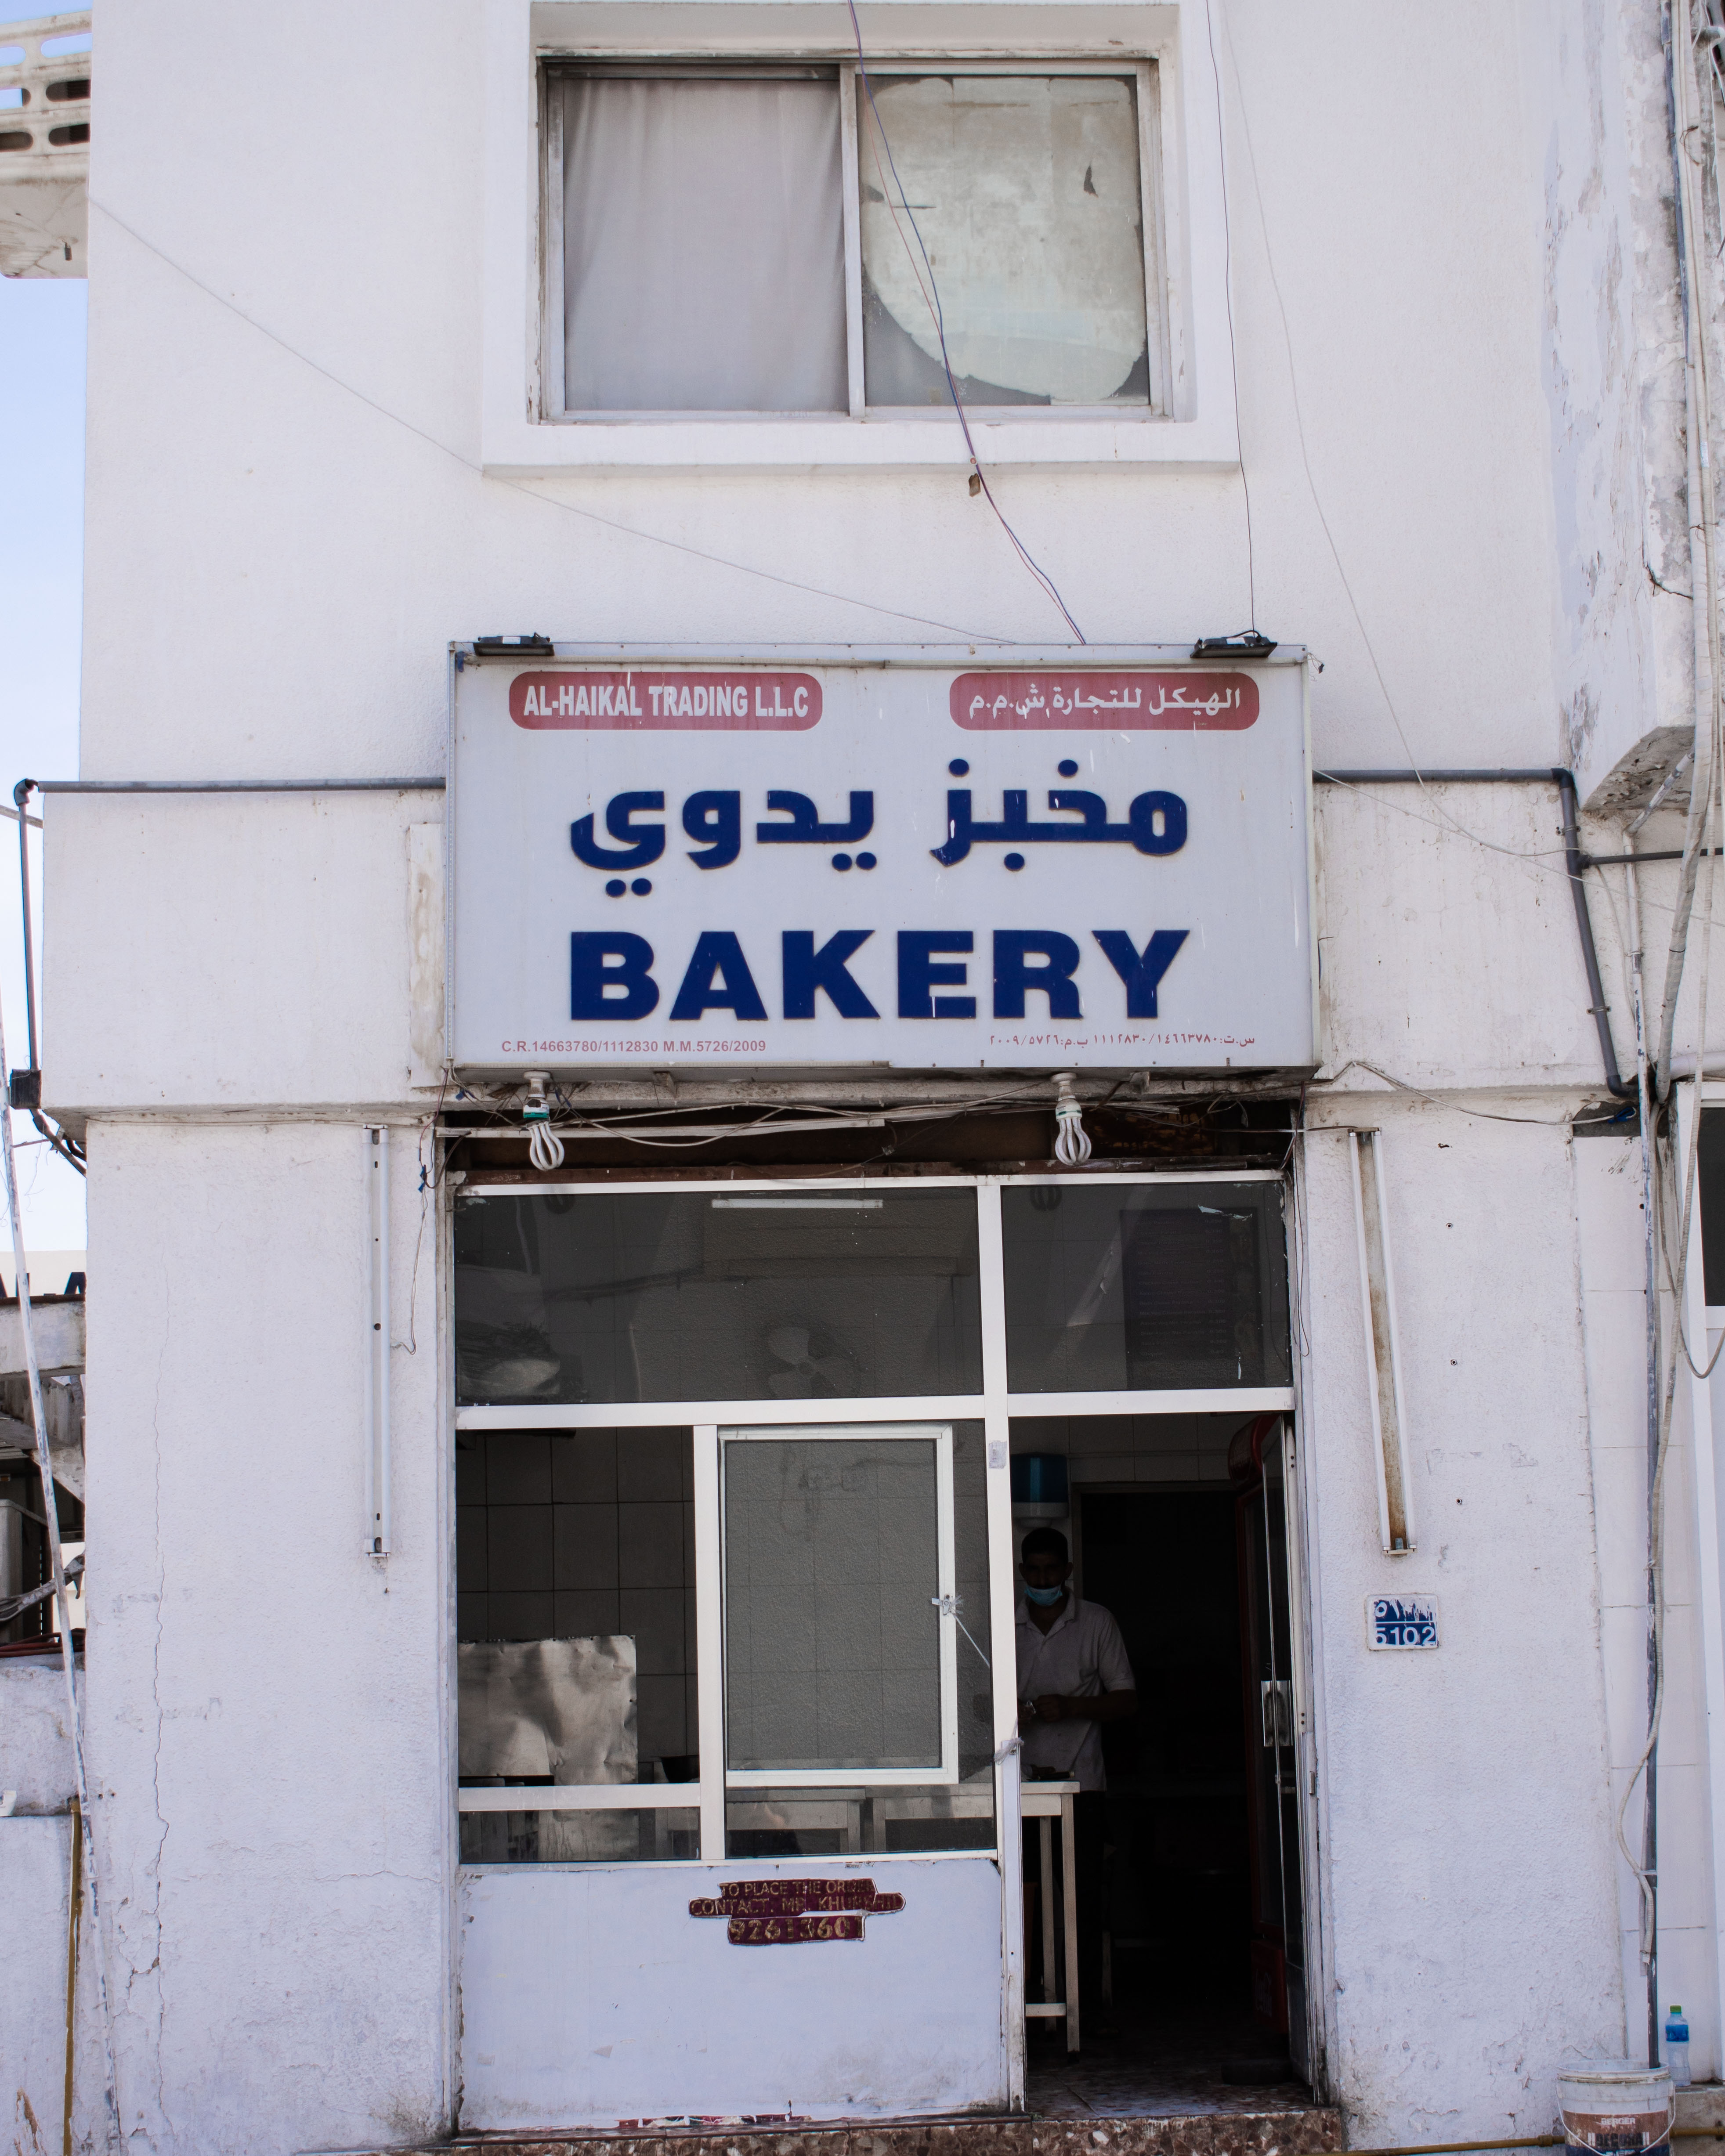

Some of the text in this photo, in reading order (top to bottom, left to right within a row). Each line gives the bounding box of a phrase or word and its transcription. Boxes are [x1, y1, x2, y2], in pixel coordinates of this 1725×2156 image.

[523, 685, 809, 718] AL-HAIKAL TRADING L.L.C
[1052, 686, 1142, 716] للتجارة
[1148, 686, 1240, 717] الهيكل
[570, 758, 1189, 898] مخبز يدوي
[570, 929, 1190, 1021] BAKERY
[501, 1040, 766, 1053] C.R.14663780/1112830 M.M.5726/2009
[1374, 1626, 1436, 1646] 5102
[720, 1883, 739, 1896] TO
[745, 1882, 788, 1896] PLACE
[792, 1881, 821, 1894] THE
